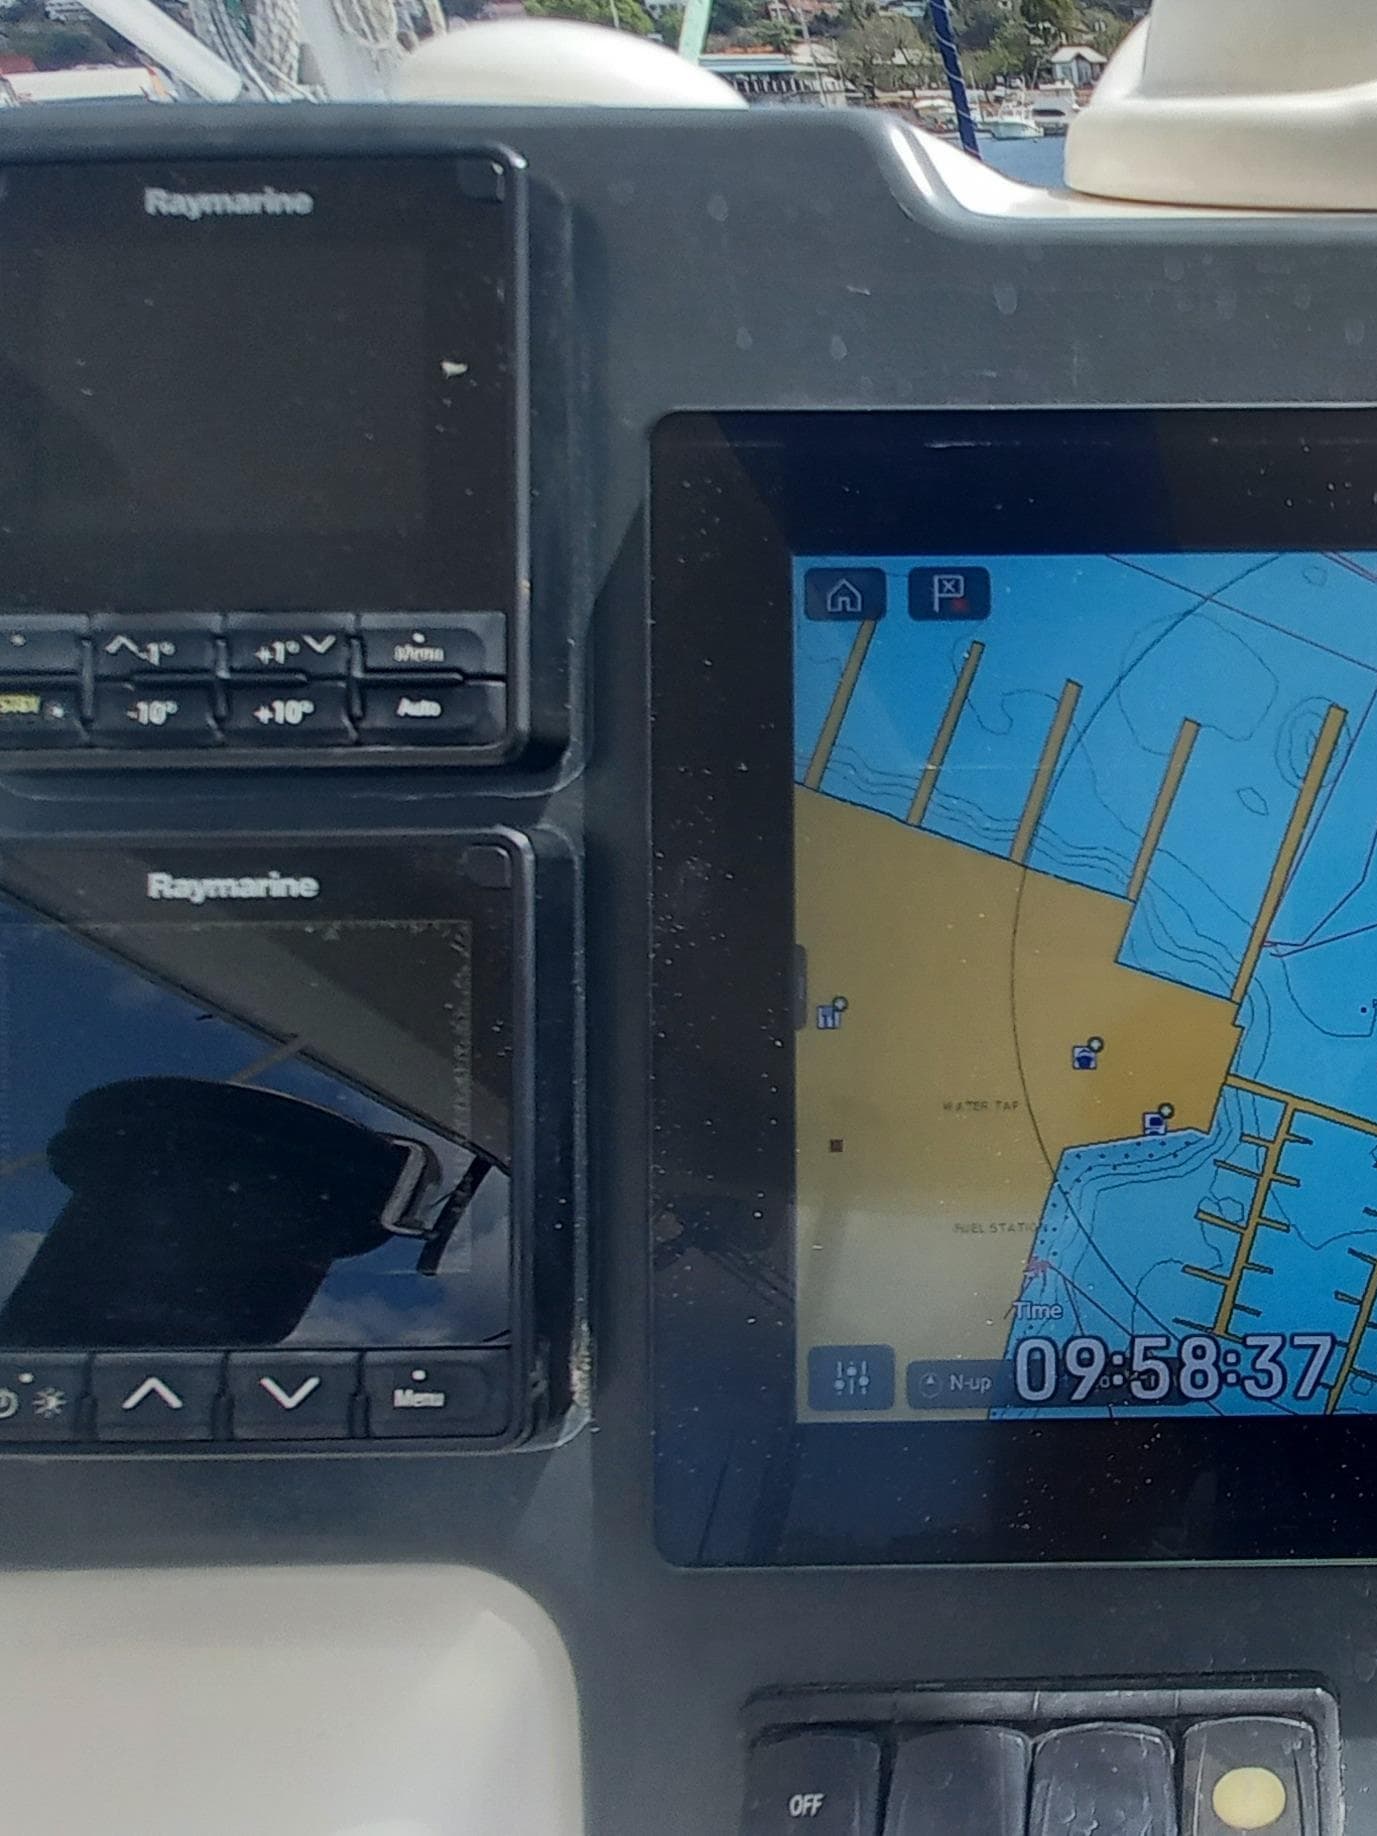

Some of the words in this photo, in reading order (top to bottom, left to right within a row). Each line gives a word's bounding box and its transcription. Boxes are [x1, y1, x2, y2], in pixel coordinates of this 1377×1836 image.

[144, 186, 314, 221] Raymarine
[147, 870, 321, 904] Raymarine
[1013, 1300, 1064, 1321] Time
[1014, 1333, 1335, 1402] 09:58:37
[949, 1373, 993, 1395] N-up
[789, 1792, 825, 1817] OFF
